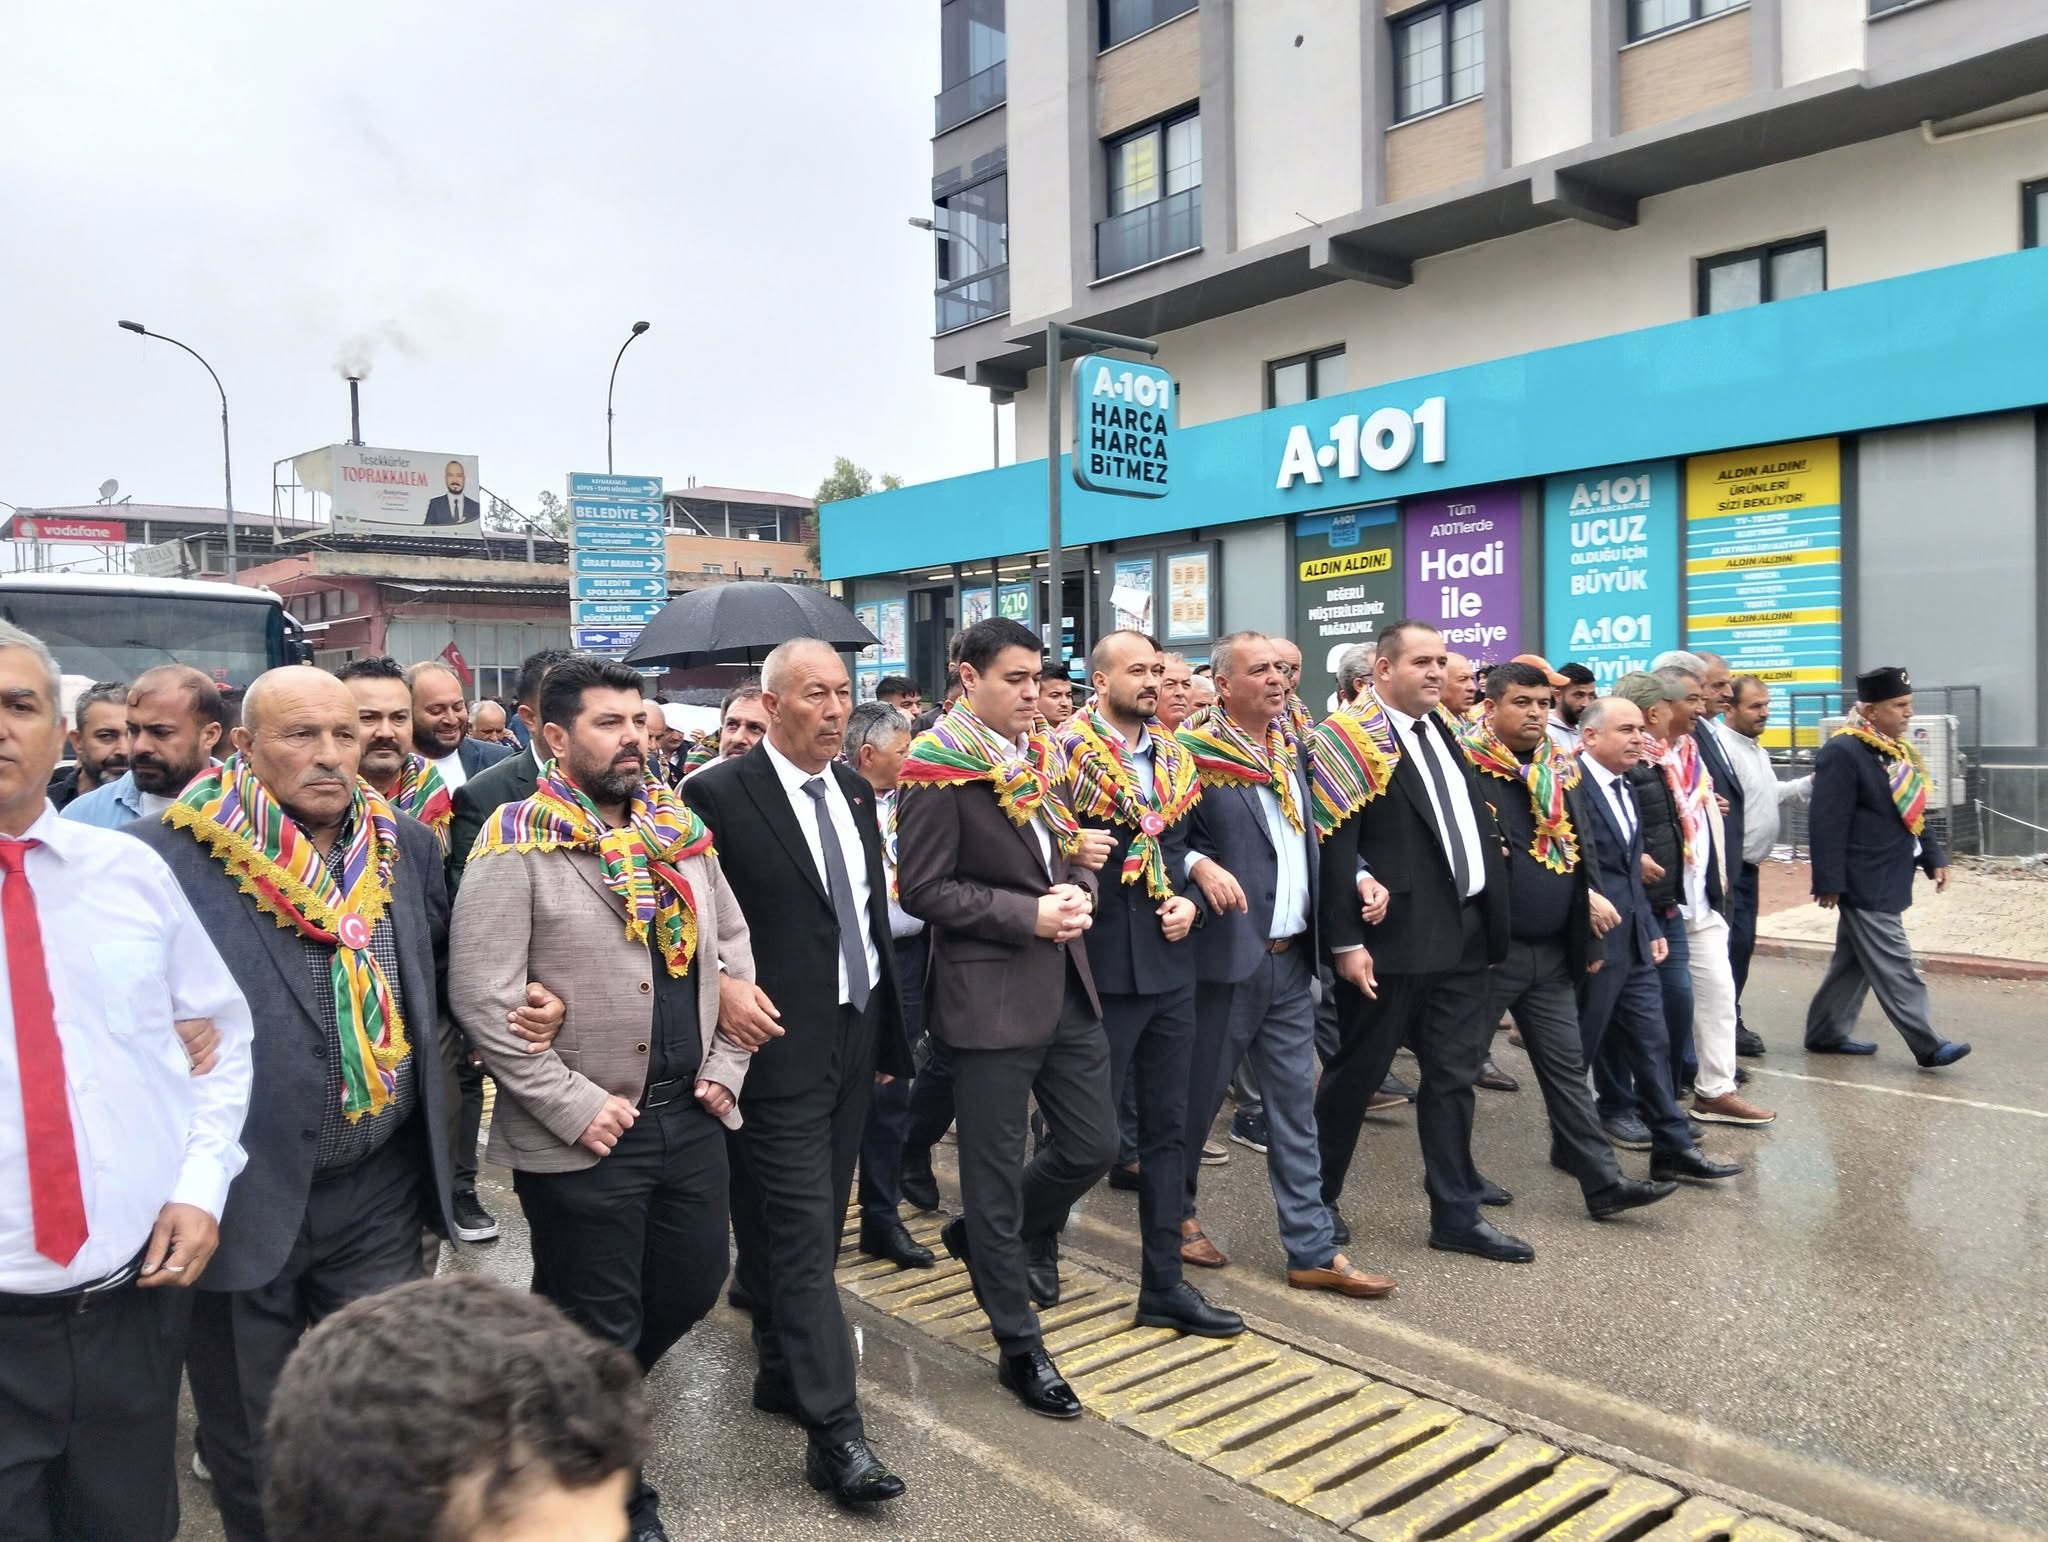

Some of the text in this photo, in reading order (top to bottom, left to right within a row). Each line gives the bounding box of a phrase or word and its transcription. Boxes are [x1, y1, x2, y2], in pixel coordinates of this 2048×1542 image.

[1092, 402, 1168, 436] HARCA
[1091, 427, 1168, 461] HARCA
[341, 466, 428, 487] TOPRAKKALEM
[1718, 465, 1758, 480] ALDIN
[1729, 478, 1790, 496] ÜRÜNLERİ
[575, 505, 639, 520] BELEDİYE
[1446, 503, 1477, 517] Tüm
[1718, 499, 1741, 511] SİZİ
[44, 525, 110, 538] vodafone
[1570, 515, 1647, 548] UCUZ
[1305, 553, 1387, 577] ALDIN ALDIN!
[1421, 540, 1504, 581] Hadi
[1570, 544, 1648, 565] OLDUĞU İÇİN
[1570, 566, 1648, 596] BÜYÜK
[586, 588, 608, 596] SPOR
[1326, 584, 1365, 602] DEĞERLİ
[1441, 586, 1482, 619] ile
[1000, 592, 1028, 614] %10
[1308, 601, 1385, 622] MÜŞTERİLERİMİZ
[1319, 620, 1374, 637] MAĞAZAMIZ
[1437, 622, 1508, 647] resiye
[1578, 655, 1649, 681] ÜYÜK
